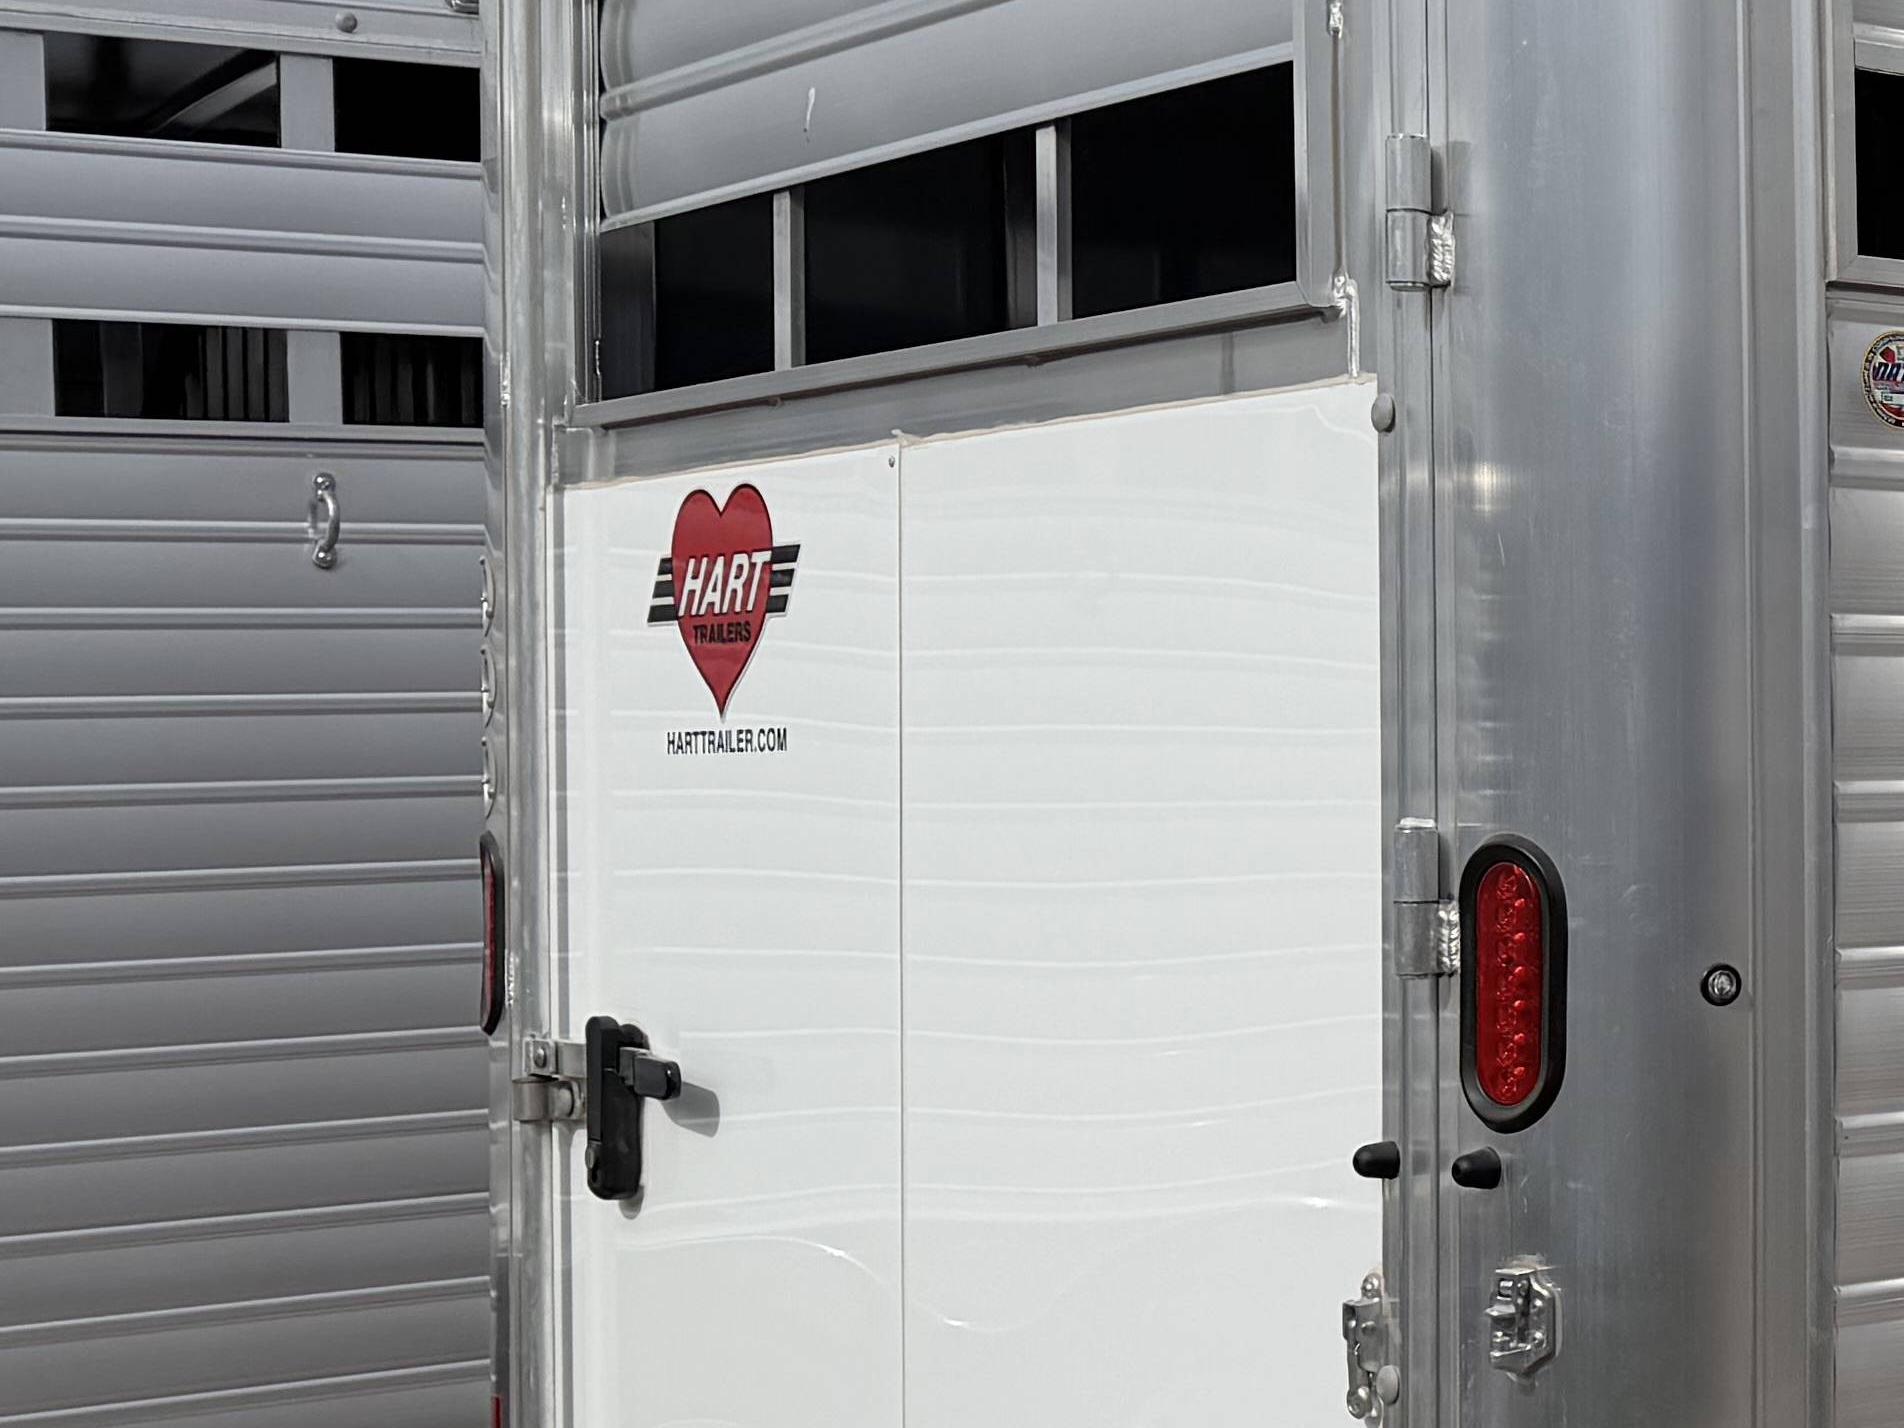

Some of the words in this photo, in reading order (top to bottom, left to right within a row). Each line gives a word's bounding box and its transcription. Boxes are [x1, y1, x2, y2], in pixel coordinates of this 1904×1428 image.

[678, 550, 772, 617] HART
[692, 621, 751, 645] TRAILERS
[666, 727, 788, 755] HARTTRAILER.COM
